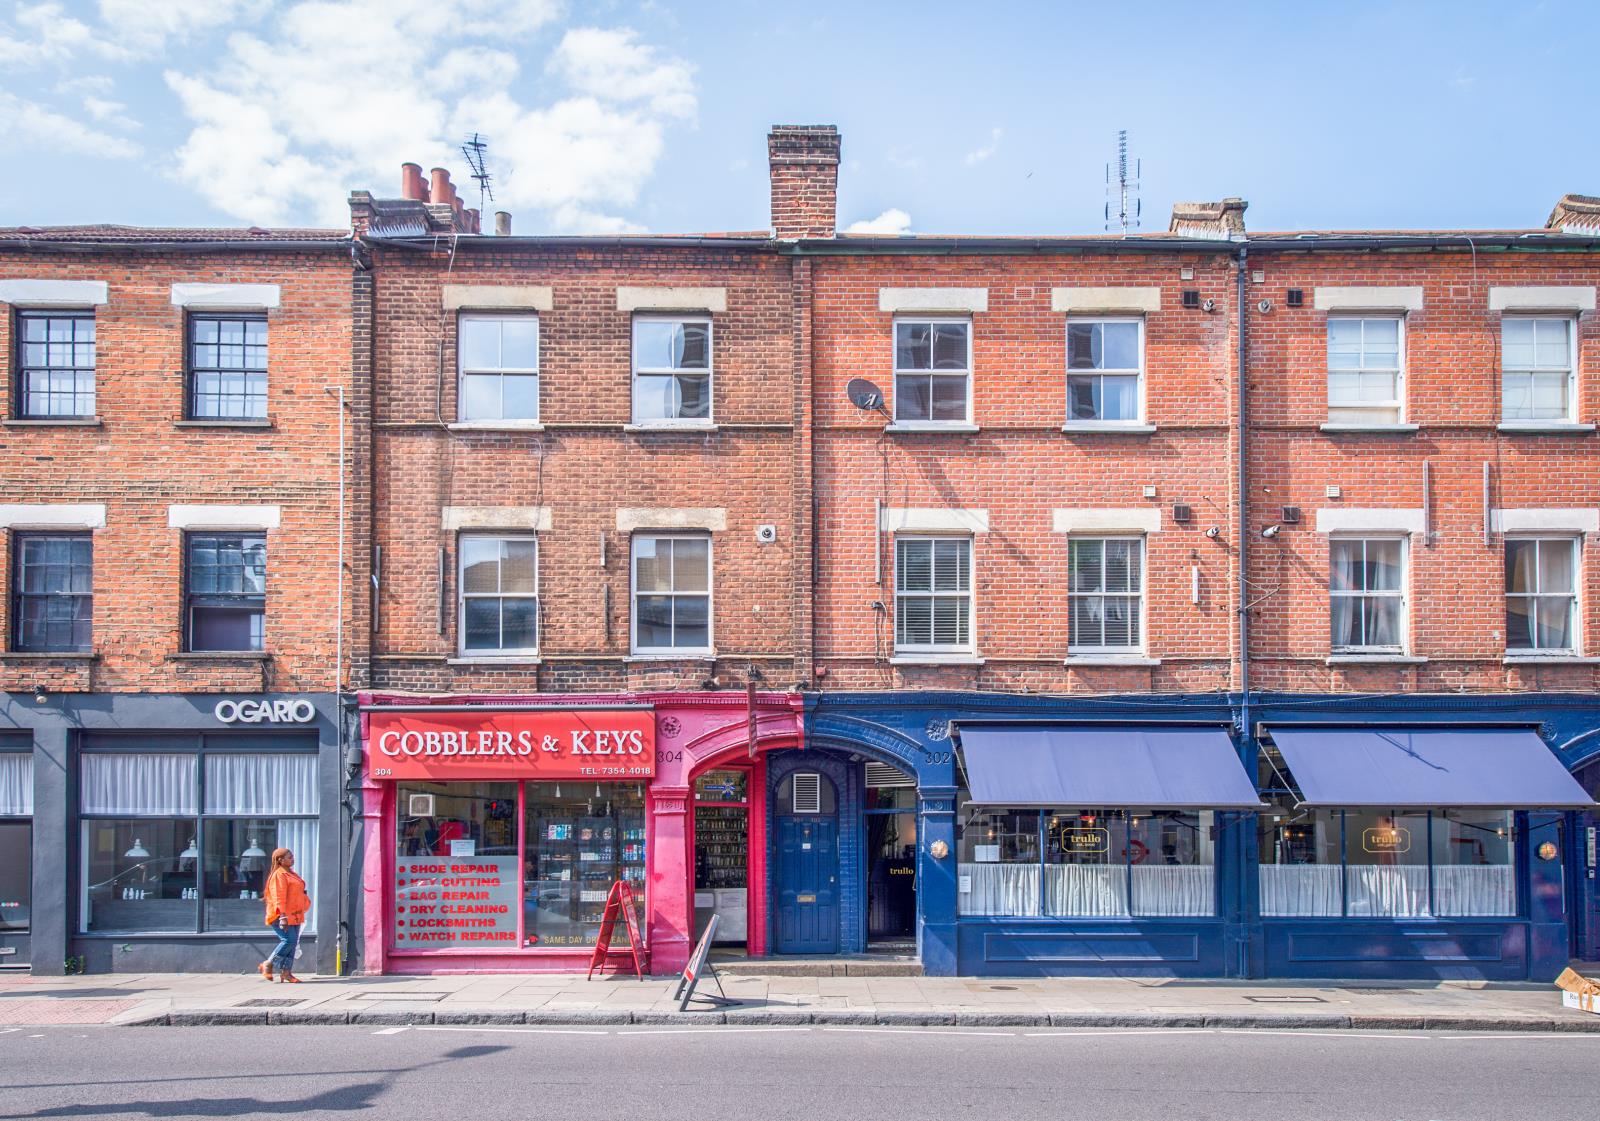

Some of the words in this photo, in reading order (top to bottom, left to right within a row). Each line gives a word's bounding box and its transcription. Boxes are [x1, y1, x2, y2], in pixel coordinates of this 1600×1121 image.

[214, 699, 316, 723] OGARIO
[379, 730, 532, 756] COBBLERS
[541, 734, 559, 752] &
[570, 730, 643, 755] KEYS
[657, 750, 682, 763] 304
[925, 751, 951, 765] 302
[375, 768, 392, 776] 304
[602, 767, 626, 775] 7354
[629, 767, 651, 775] 4018
[1071, 833, 1101, 843] trullo
[410, 864, 447, 874] SHOE
[451, 864, 499, 874] REPAIR
[889, 866, 914, 875] trullo
[410, 877, 437, 887] KEY
[441, 877, 501, 887] CUTTING
[410, 891, 438, 901] BAG
[442, 891, 490, 901] REPAIR
[410, 904, 437, 914] DRY
[440, 904, 509, 914] CLEANING
[409, 918, 497, 928] LOCKSMITHS
[409, 931, 457, 941] WATCH
[461, 931, 517, 941] REPAIRS
[544, 936, 566, 944] SAME
[568, 936, 583, 944] DAY
[586, 936, 600, 944] DR
